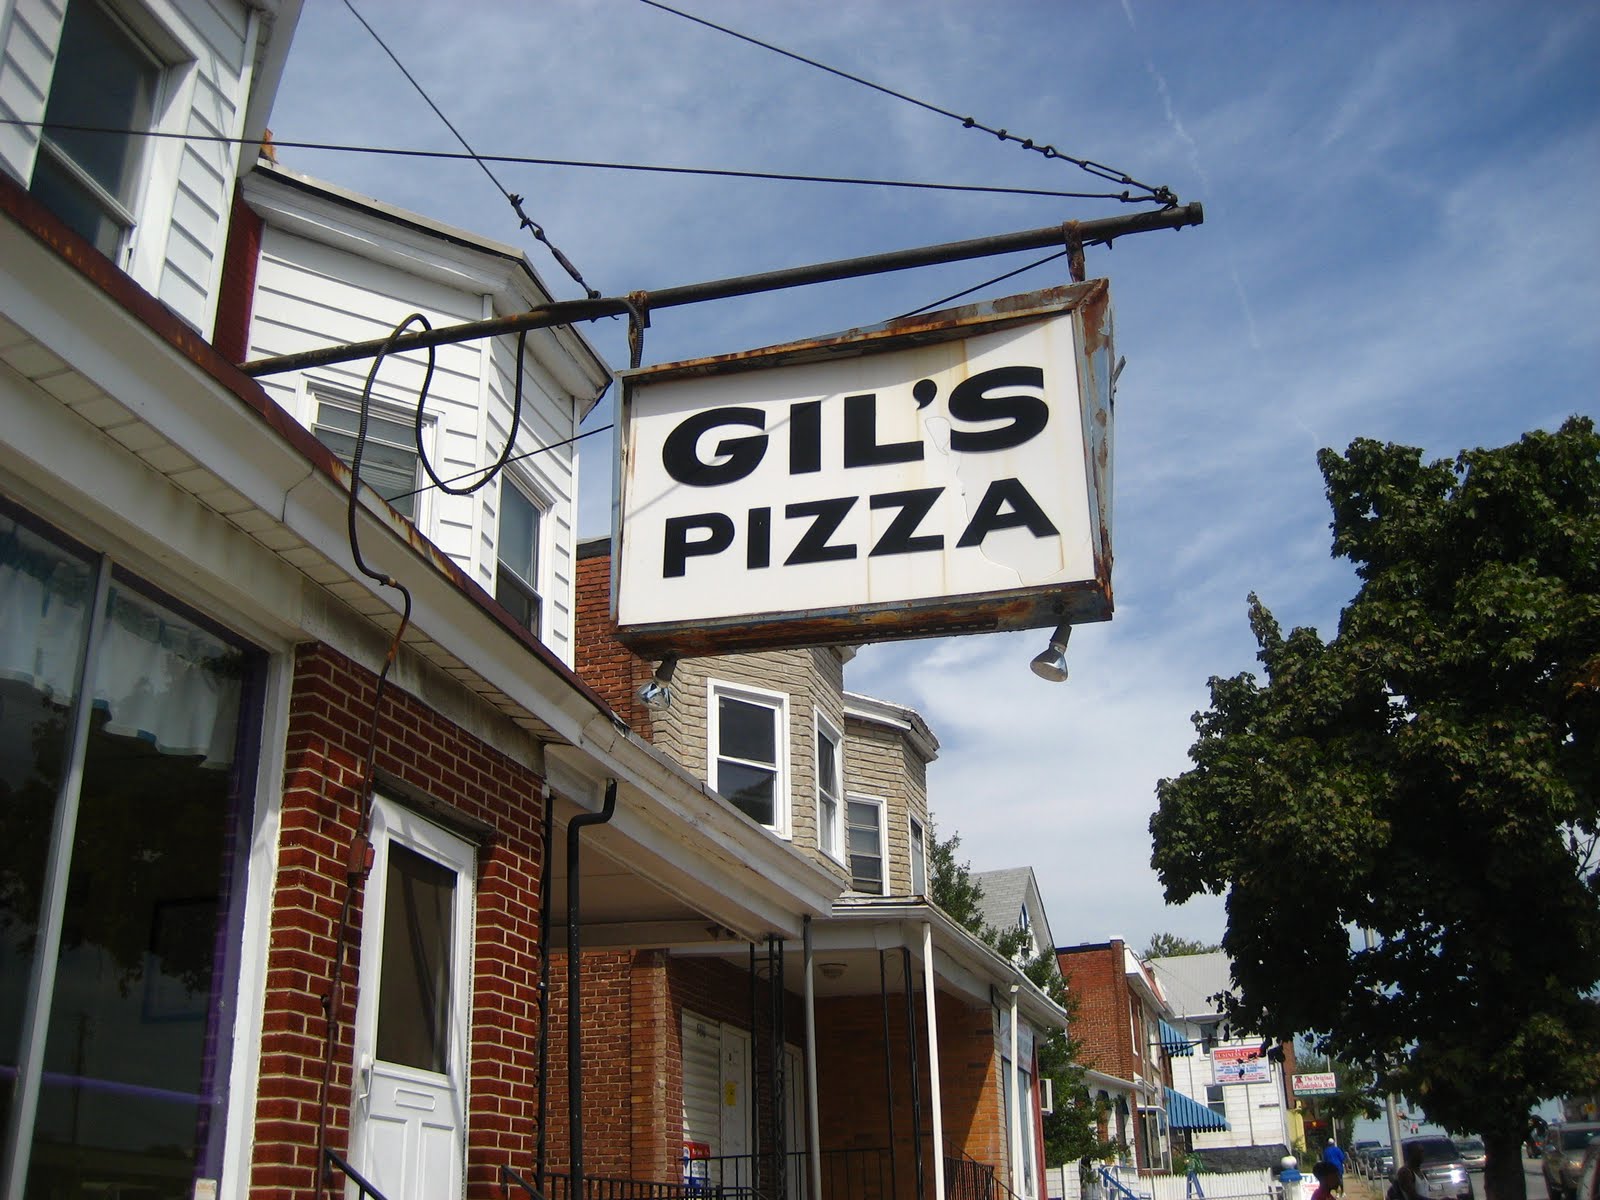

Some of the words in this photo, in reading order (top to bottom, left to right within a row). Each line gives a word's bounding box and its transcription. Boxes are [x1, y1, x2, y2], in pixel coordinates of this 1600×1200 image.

[662, 366, 1049, 487] GIL'S
[662, 477, 1060, 578] PIZZA
[1313, 1074, 1333, 1082] Original
